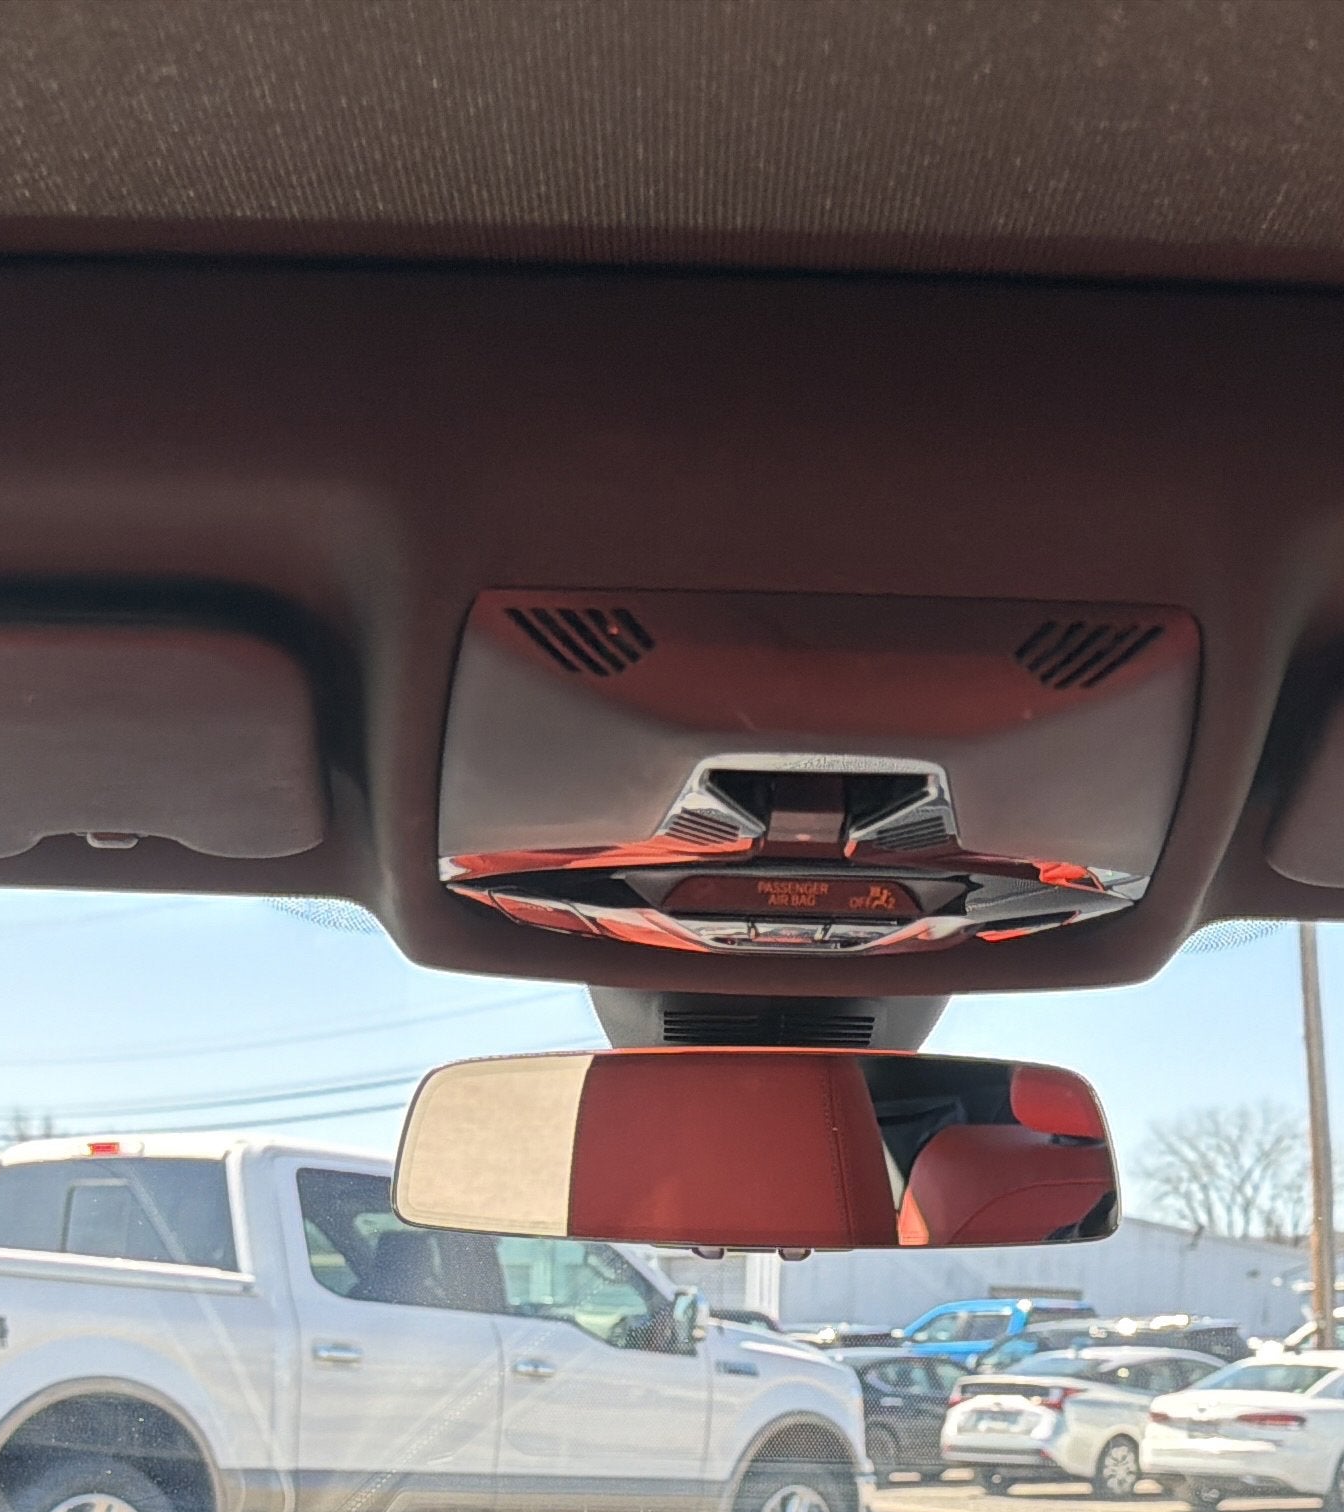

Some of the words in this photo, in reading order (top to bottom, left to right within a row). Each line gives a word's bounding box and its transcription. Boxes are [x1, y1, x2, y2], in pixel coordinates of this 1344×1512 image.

[758, 881, 829, 894] PASSENGER
[768, 894, 788, 906] AIR
[791, 895, 816, 907] BAG
